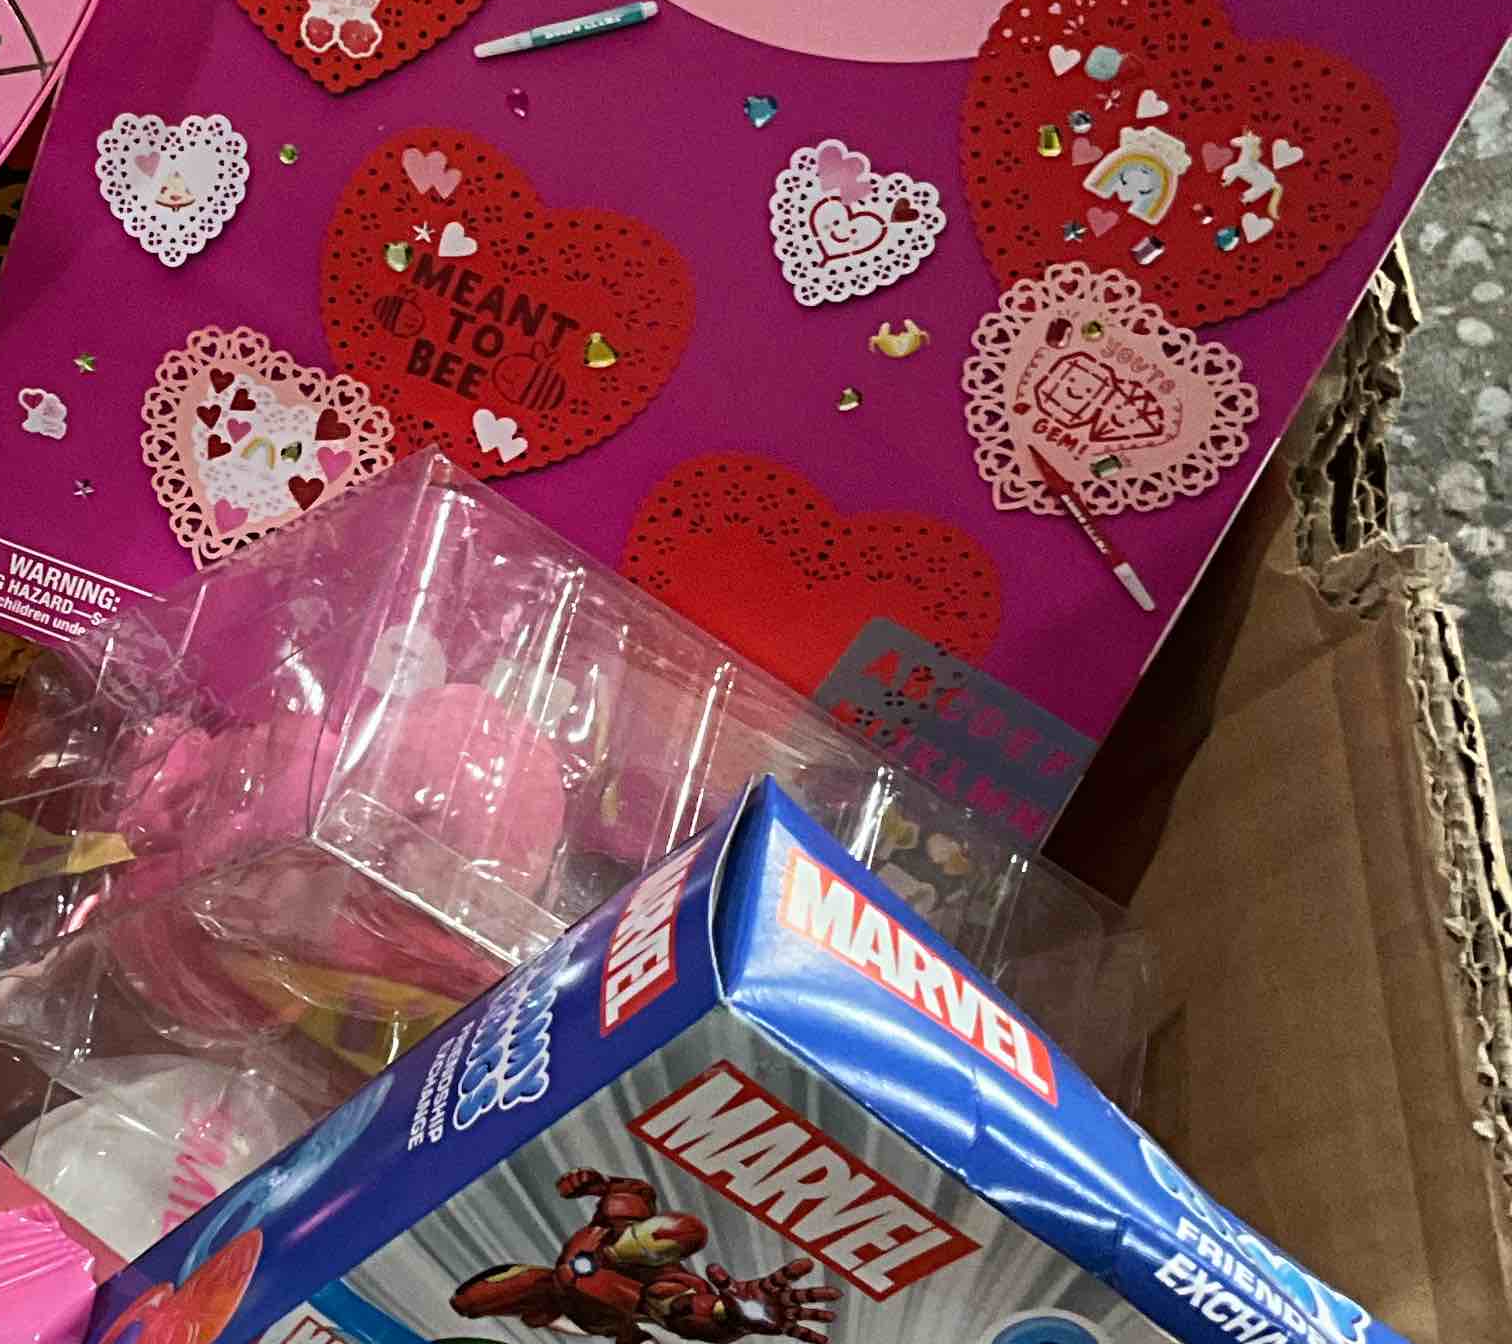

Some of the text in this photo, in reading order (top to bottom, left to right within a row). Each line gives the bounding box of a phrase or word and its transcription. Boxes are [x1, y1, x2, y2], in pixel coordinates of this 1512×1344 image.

[411, 253, 581, 349] MEANT
[447, 307, 505, 358] TO
[405, 338, 487, 402] BEE
[1033, 418, 1090, 461] GEM!
[9, 552, 122, 613] WARNING:
[52, 613, 88, 637] unde
[788, 855, 1049, 1093] MARVEL
[640, 1070, 954, 1293] MARVEL
